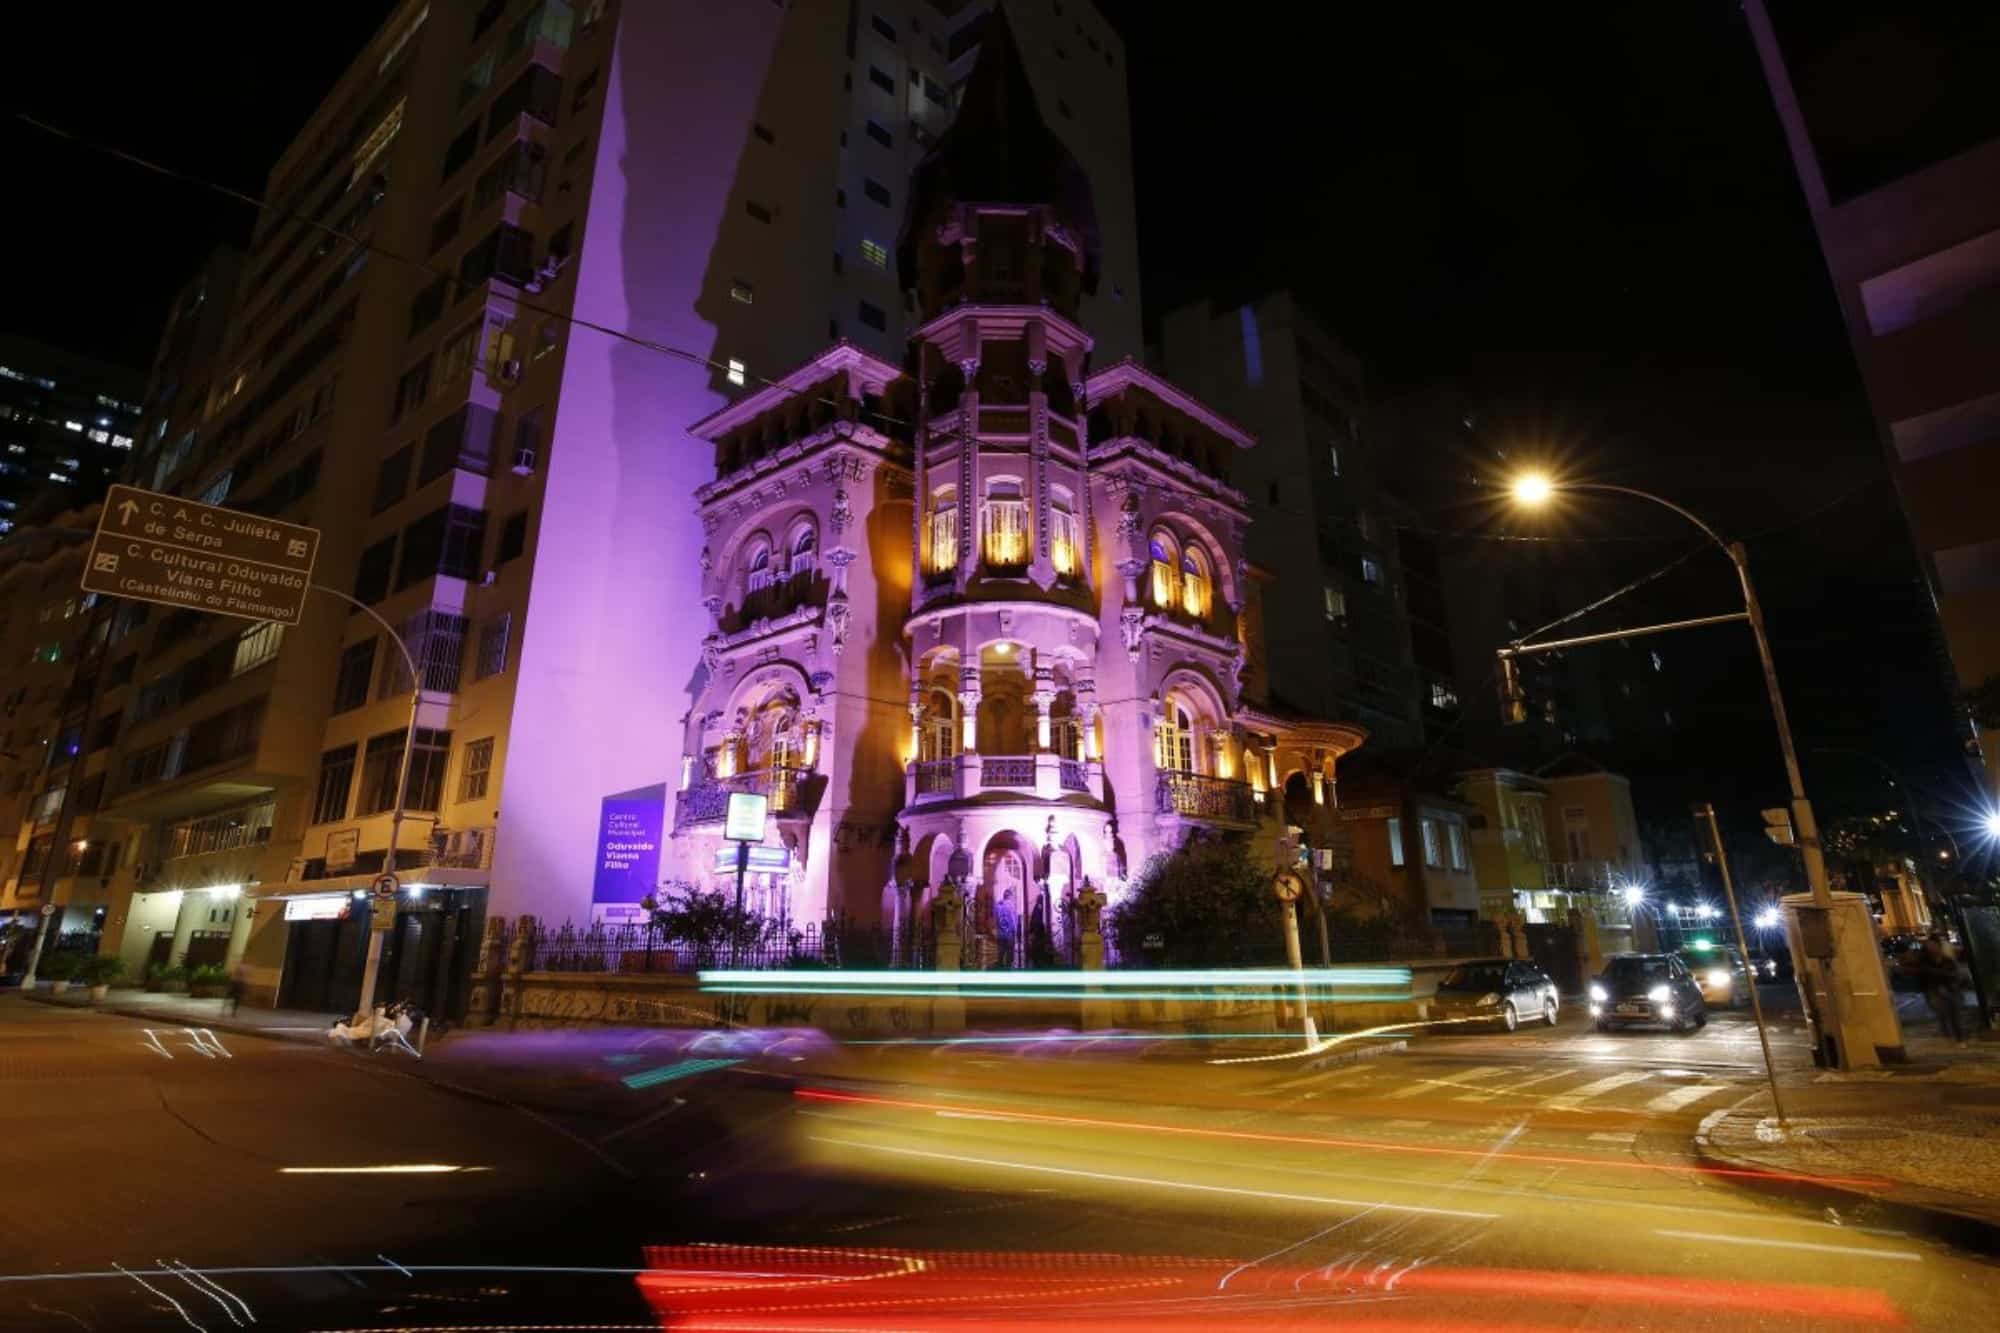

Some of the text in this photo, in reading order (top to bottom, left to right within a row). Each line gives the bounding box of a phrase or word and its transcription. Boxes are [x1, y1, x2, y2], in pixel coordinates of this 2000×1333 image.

[145, 521, 224, 548] de Serpa
[150, 502, 281, 542] C. A. C. Julieta
[127, 543, 303, 588] C. Cultural Oduvaldo
[167, 569, 263, 598] Viana Filho
[119, 578, 295, 618] (Castelinho do Flamengo)
[606, 842, 655, 852] Oduvaldo
[606, 851, 640, 861] Vianna
[604, 860, 630, 870] Filho
[381, 879, 392, 893] E
